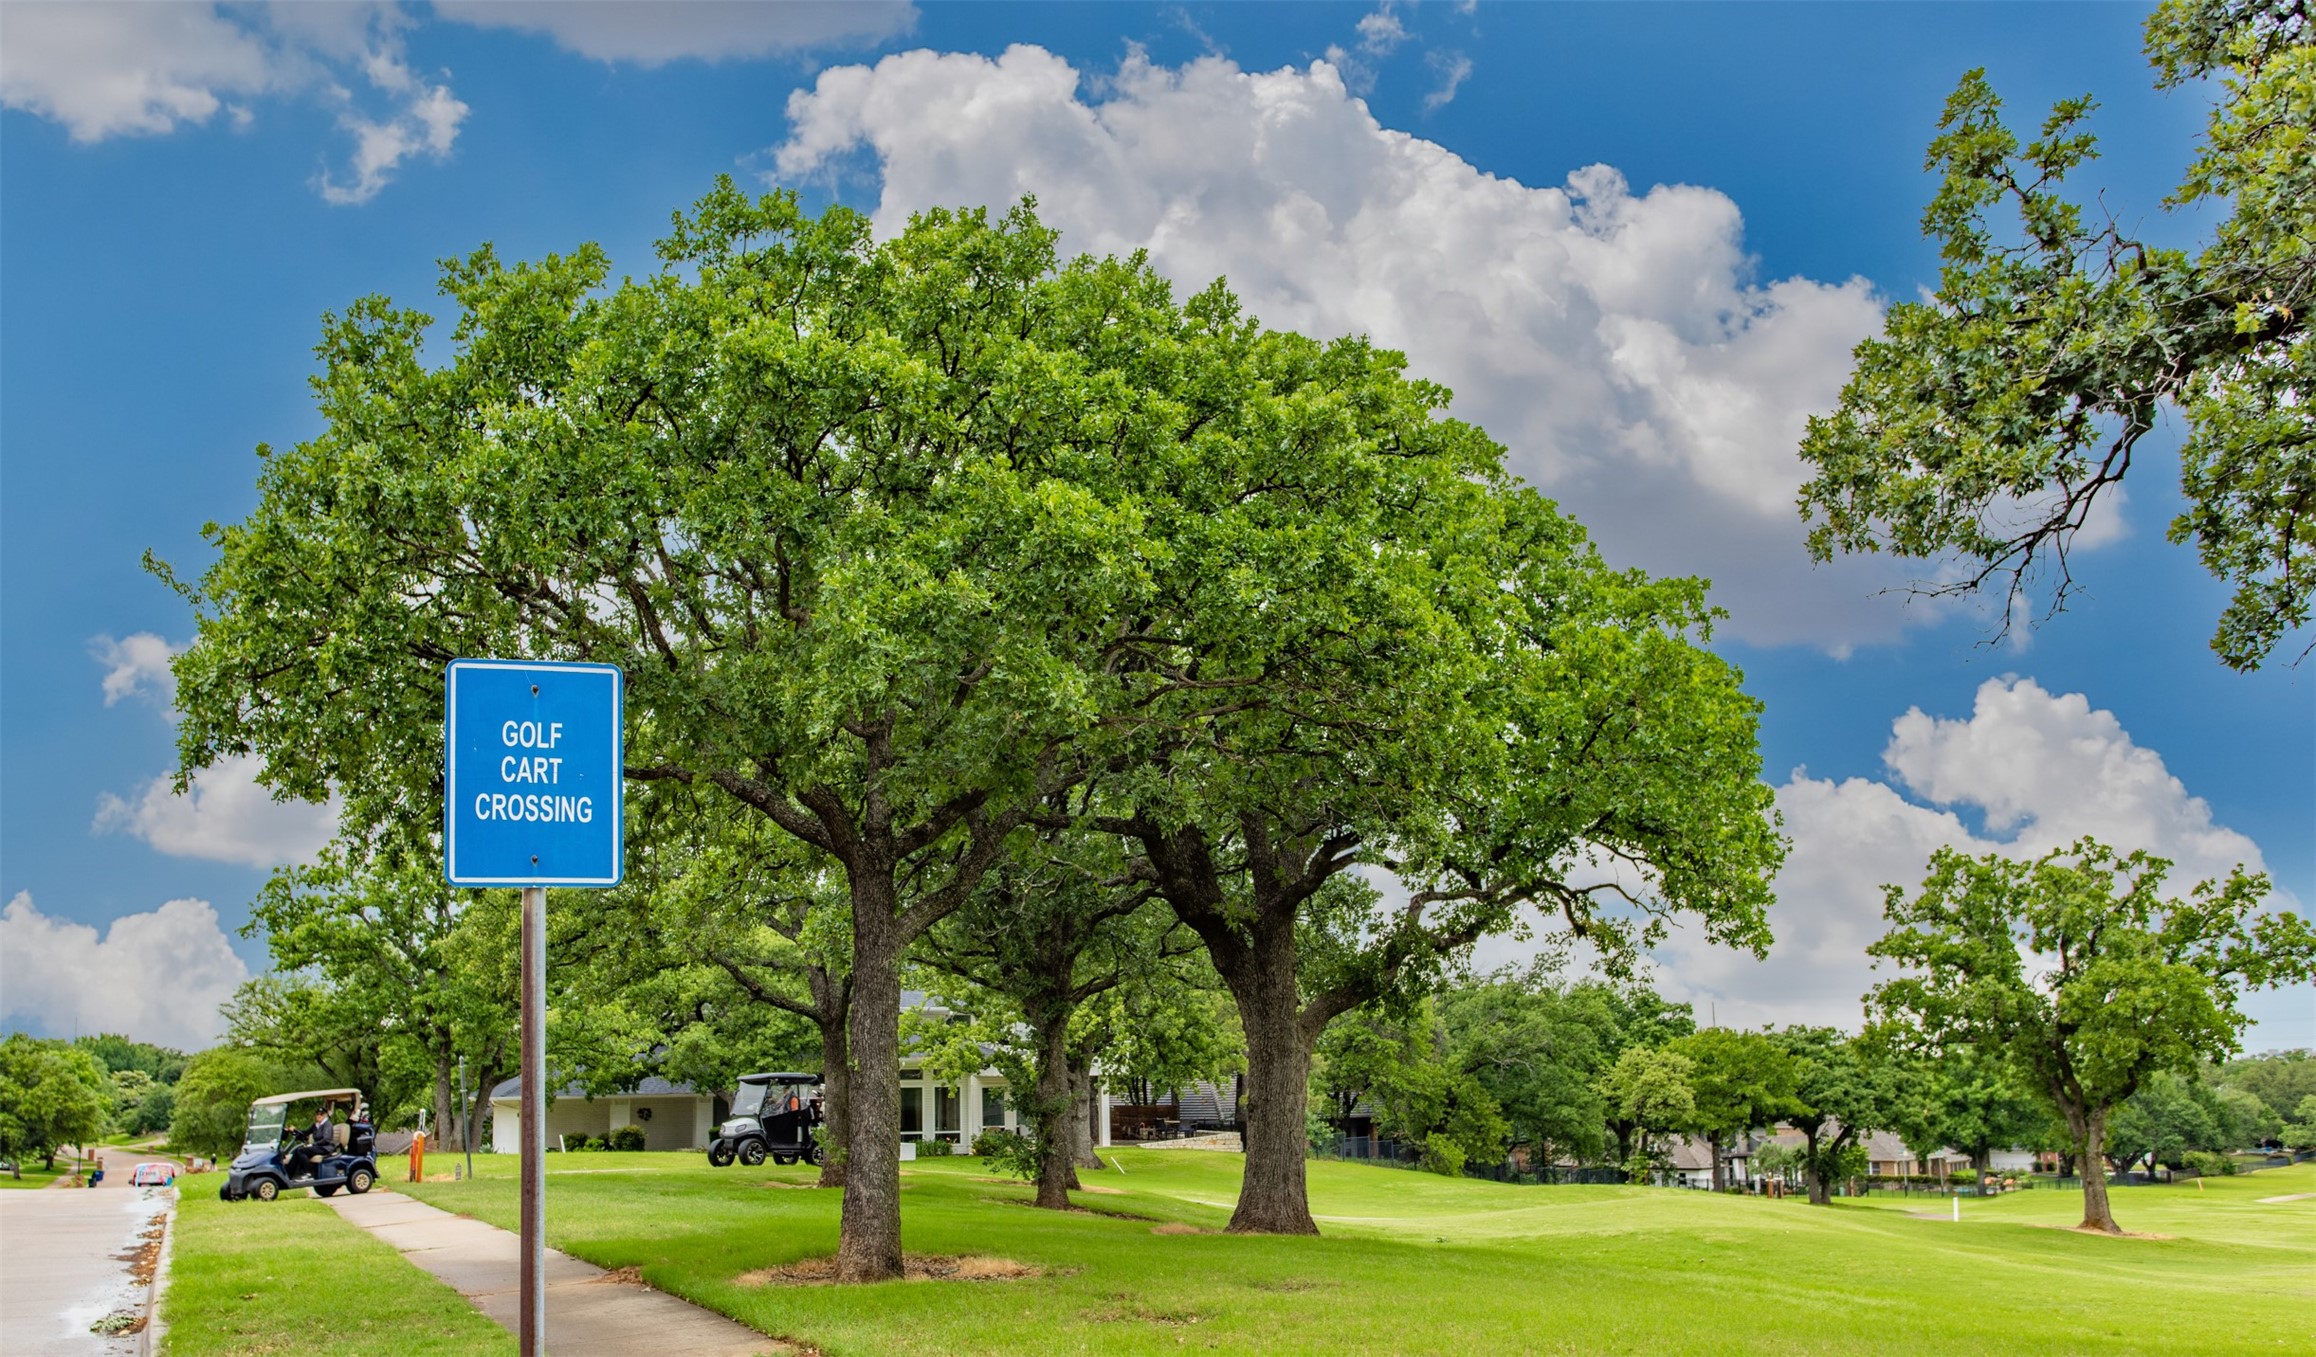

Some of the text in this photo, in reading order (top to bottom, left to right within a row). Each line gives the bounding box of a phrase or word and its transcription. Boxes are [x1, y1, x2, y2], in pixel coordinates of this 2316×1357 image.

[502, 720, 563, 748] GOLF
[501, 756, 563, 784] CART
[475, 793, 593, 823] CROSSING
